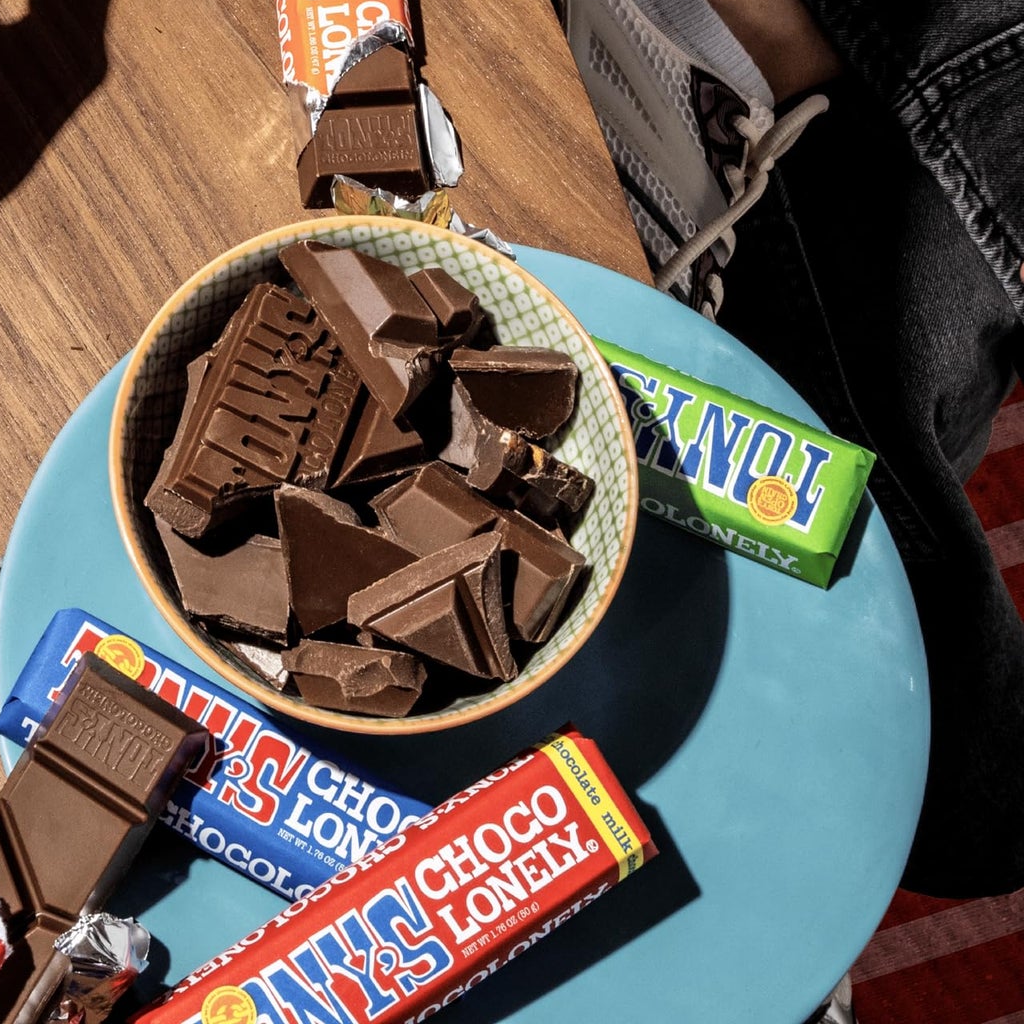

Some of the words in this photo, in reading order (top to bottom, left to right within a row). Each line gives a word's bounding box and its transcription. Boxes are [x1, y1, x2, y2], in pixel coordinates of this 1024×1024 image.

[57, 698, 166, 793] TONY'S
[414, 752, 538, 831] TONY'S
[277, 828, 294, 843] NET
[294, 837, 308, 850] WT
[307, 845, 324, 861] 1.76
[323, 854, 336, 868] OZ
[283, 792, 386, 864] LON
[414, 784, 569, 902] CHOCO
[601, 810, 634, 855] milk
[461, 941, 479, 959] NET
[477, 933, 492, 950] WT
[491, 923, 507, 939] 1.76
[505, 915, 518, 929] OZ
